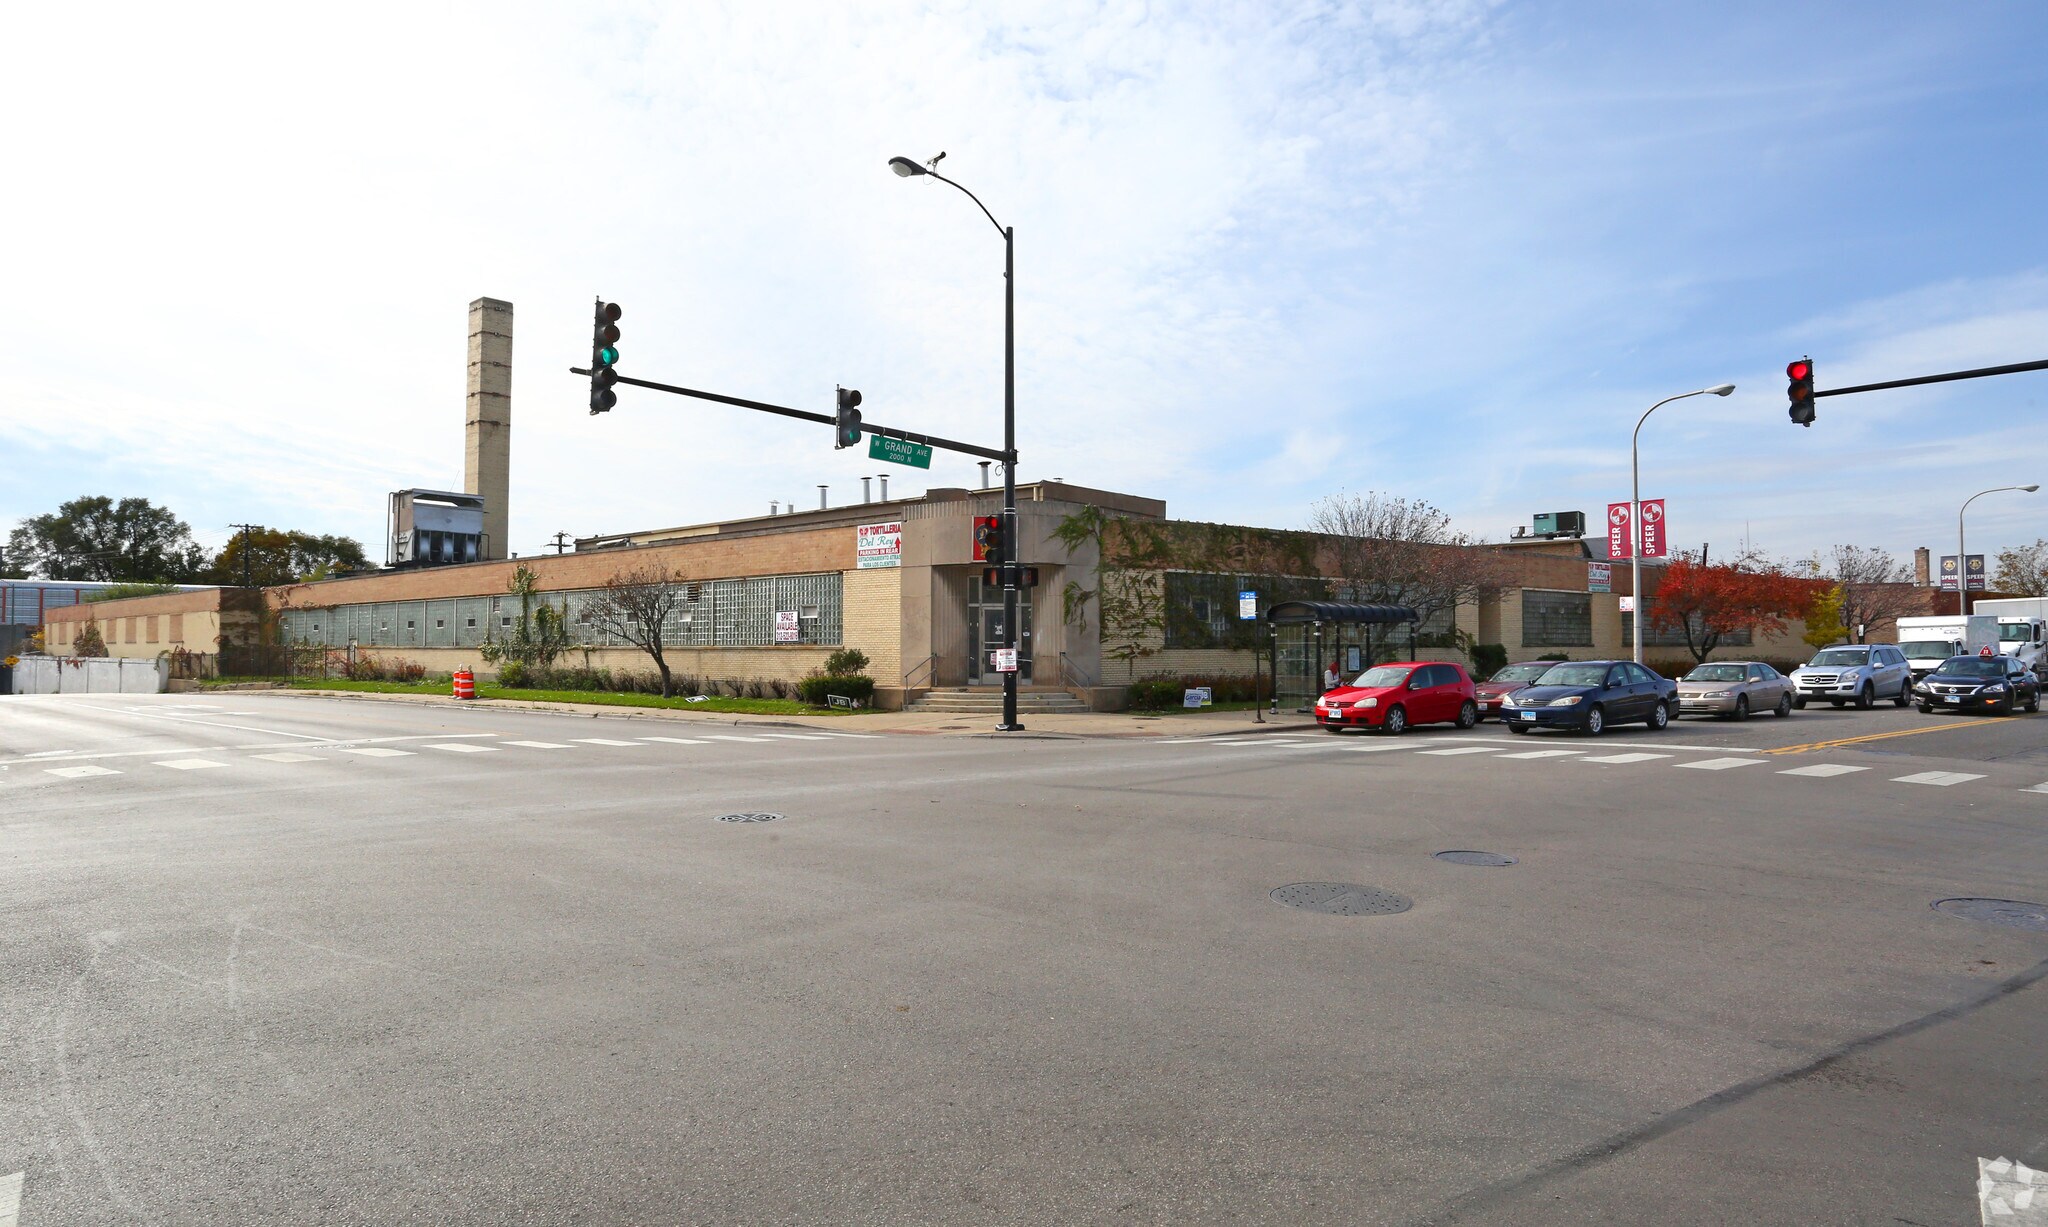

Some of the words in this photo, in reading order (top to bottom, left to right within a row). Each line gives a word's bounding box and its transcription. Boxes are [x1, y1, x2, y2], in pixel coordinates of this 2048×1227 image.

[885, 441, 912, 454] GRAND
[889, 452, 905, 462] 2000
[870, 524, 901, 535] TORTILLERIA
[858, 537, 875, 548] Del
[876, 535, 894, 548] Rey
[1612, 527, 1621, 556] SPEER
[1645, 524, 1655, 555] SPEER
[886, 547, 899, 555] REAR
[781, 613, 793, 621] SPACE
[777, 622, 798, 630] AVAILABLE
